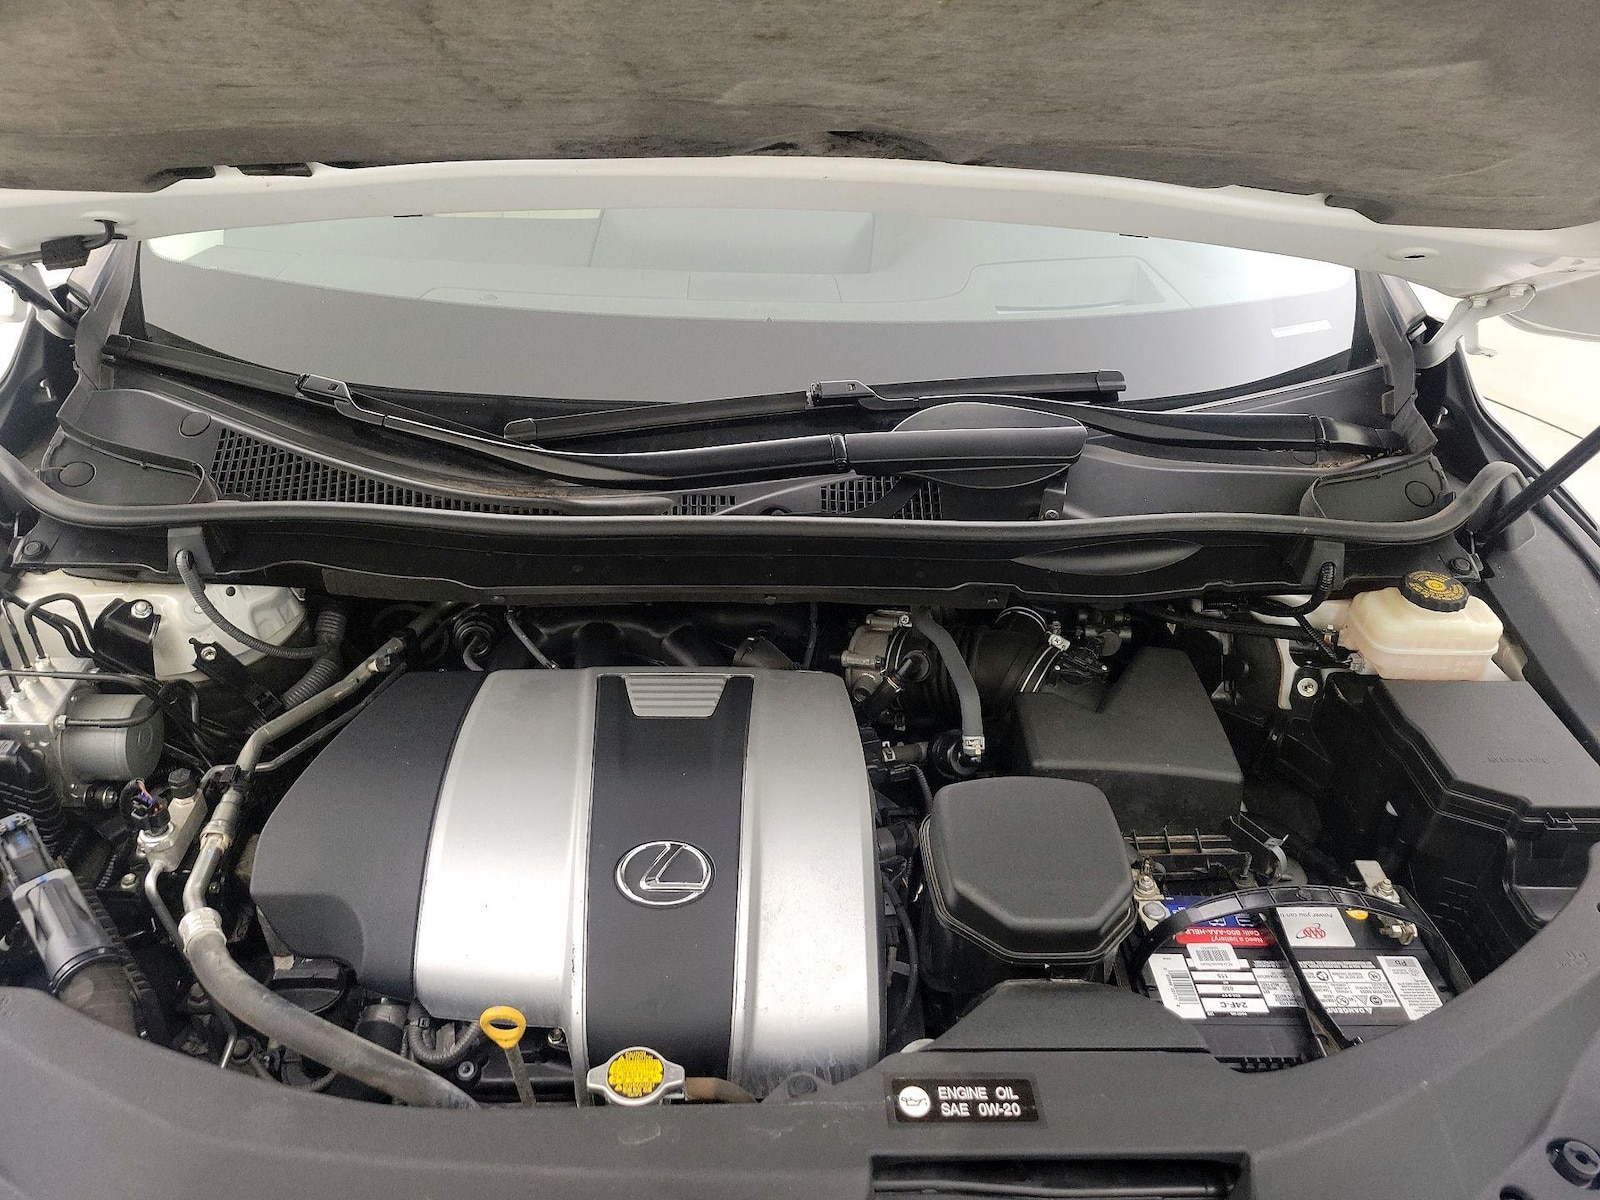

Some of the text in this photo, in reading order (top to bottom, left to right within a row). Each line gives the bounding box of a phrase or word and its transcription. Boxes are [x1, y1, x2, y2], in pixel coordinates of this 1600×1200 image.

[1211, 934, 1239, 942] battery?
[1219, 1001, 1248, 1009] 24F-C
[937, 1086, 1020, 1100] ENGINE OIL
[940, 1102, 1021, 1117] SAE 0W-20
